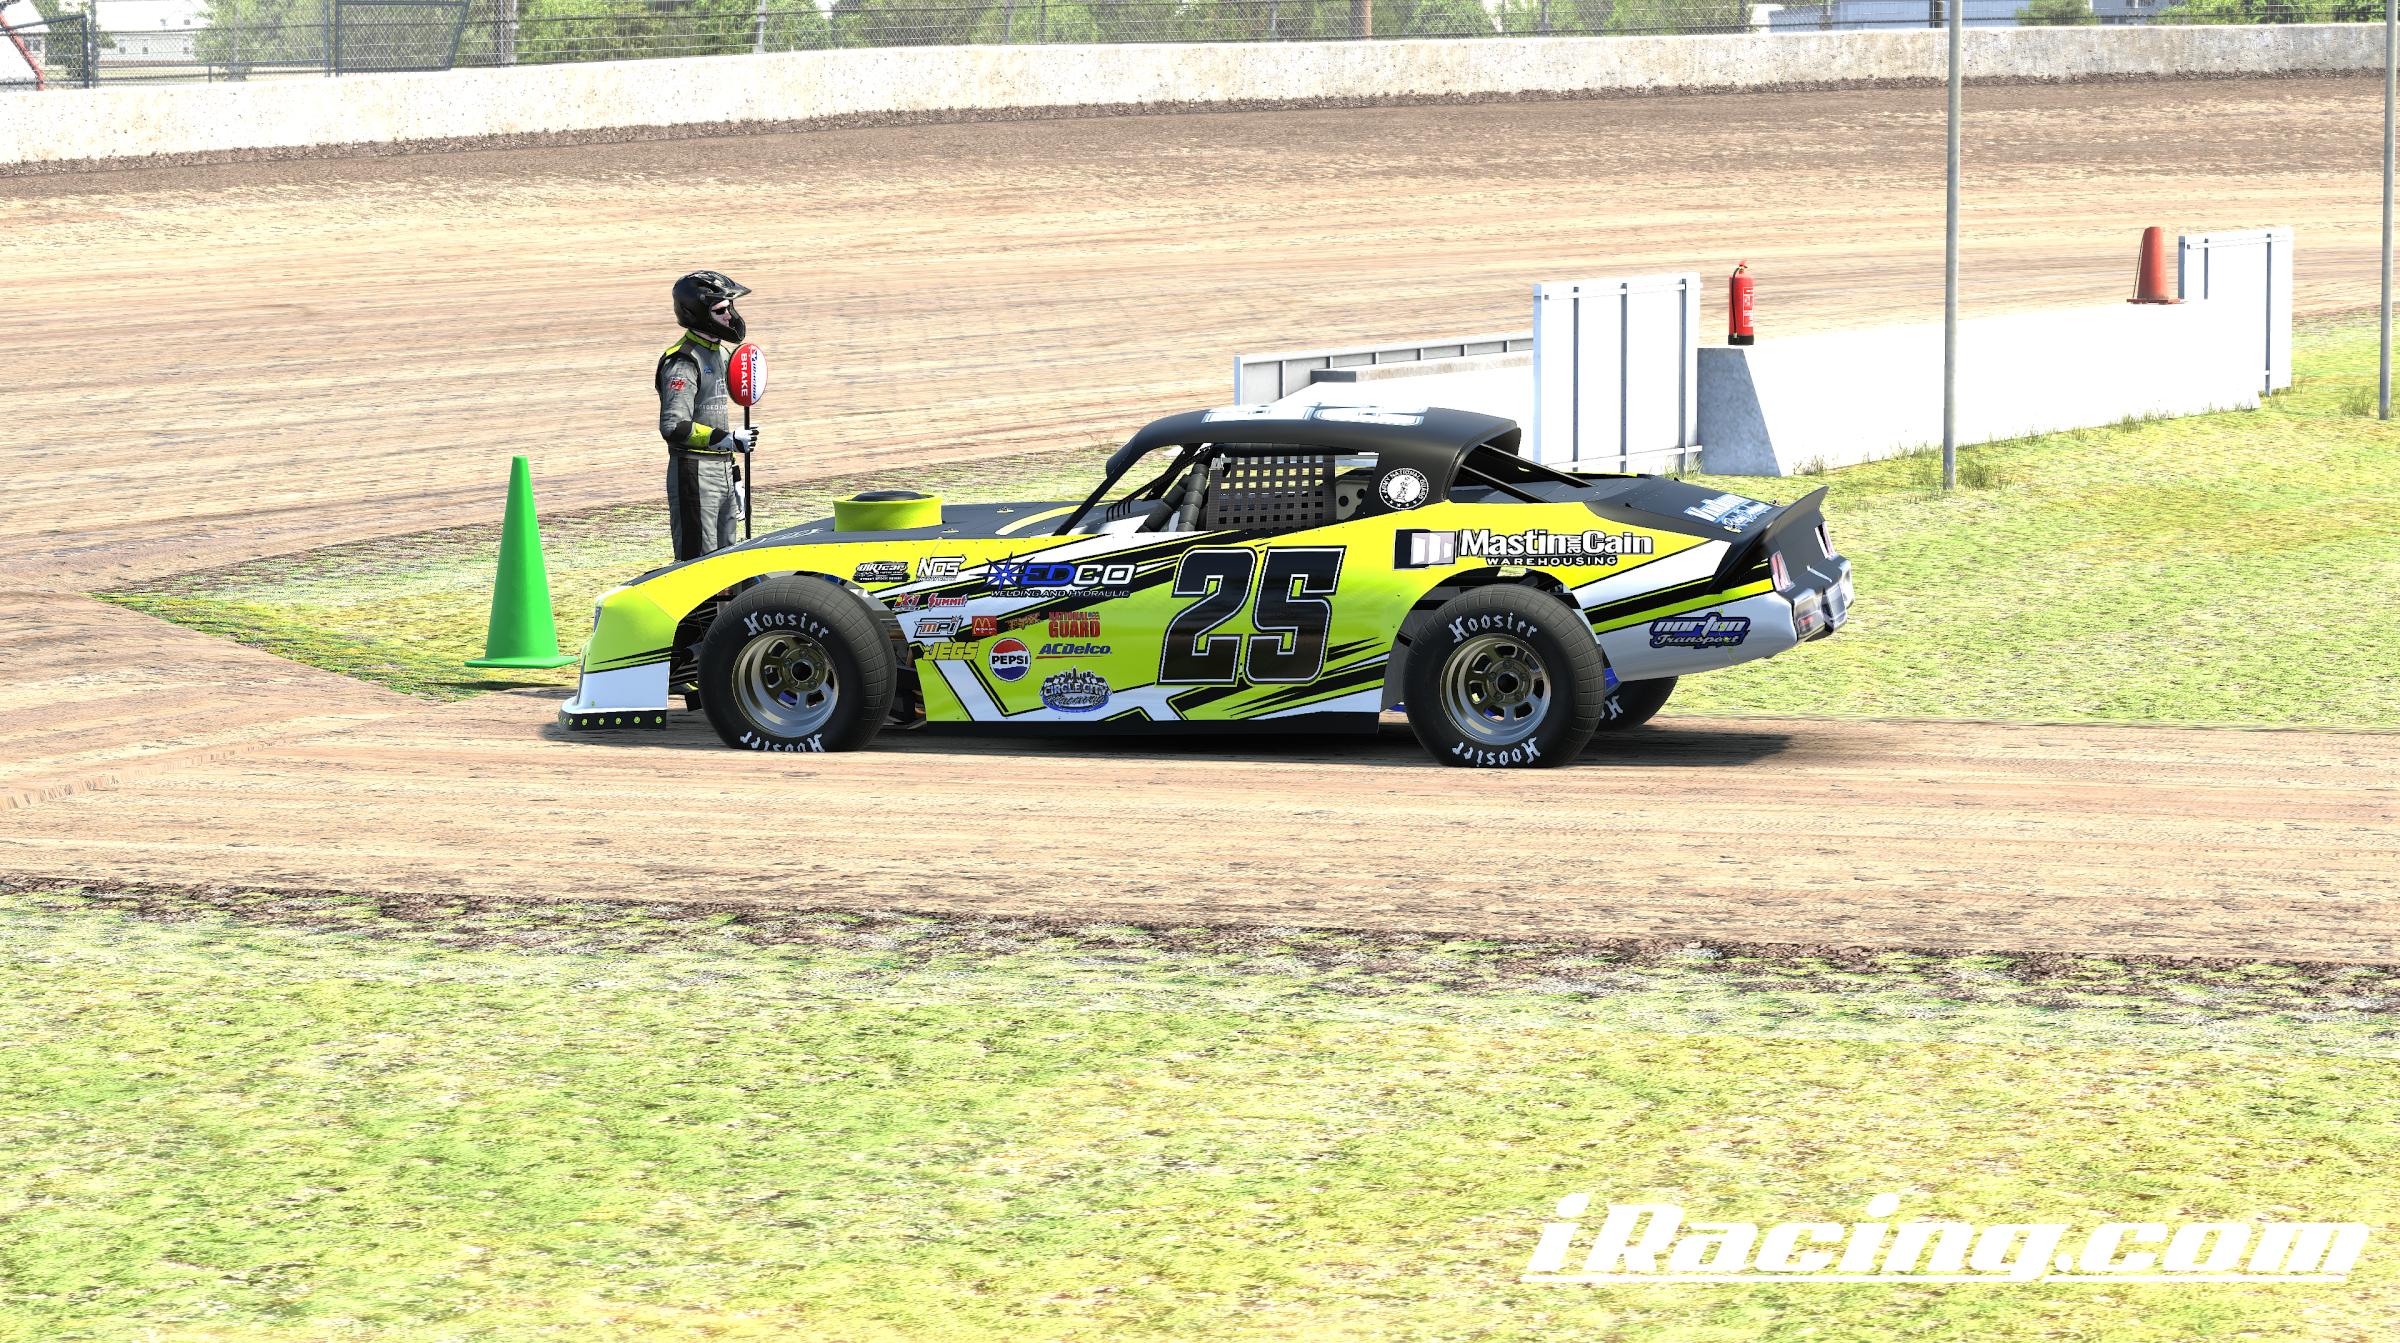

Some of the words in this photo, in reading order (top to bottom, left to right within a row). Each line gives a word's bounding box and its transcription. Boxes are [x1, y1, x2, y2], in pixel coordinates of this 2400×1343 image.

[741, 352, 749, 397] BRAKE
[1459, 529, 1567, 556] Mastin
[1566, 536, 1582, 555] and
[1582, 529, 1655, 556] Cain
[916, 556, 964, 577] NOS
[1487, 556, 1618, 566] WAREHOUSING
[1021, 564, 1136, 586] EDCO
[991, 590, 1041, 598] WELDING
[1069, 589, 1131, 597] HYDRAULIC
[744, 611, 829, 638] Hoosier
[1156, 545, 1347, 686] 25
[1048, 621, 1101, 638] GUARD
[1449, 612, 1538, 644] Hoosier
[1653, 615, 1747, 638] norton
[1038, 643, 1111, 655] ACDelco
[1654, 634, 1739, 645] Transport
[924, 641, 979, 661] JEGS
[991, 654, 1029, 665] PEPSI
[1044, 683, 1081, 696] CIRCLE
[1082, 683, 1108, 696] CITY
[1452, 736, 1541, 767] Hoosier
